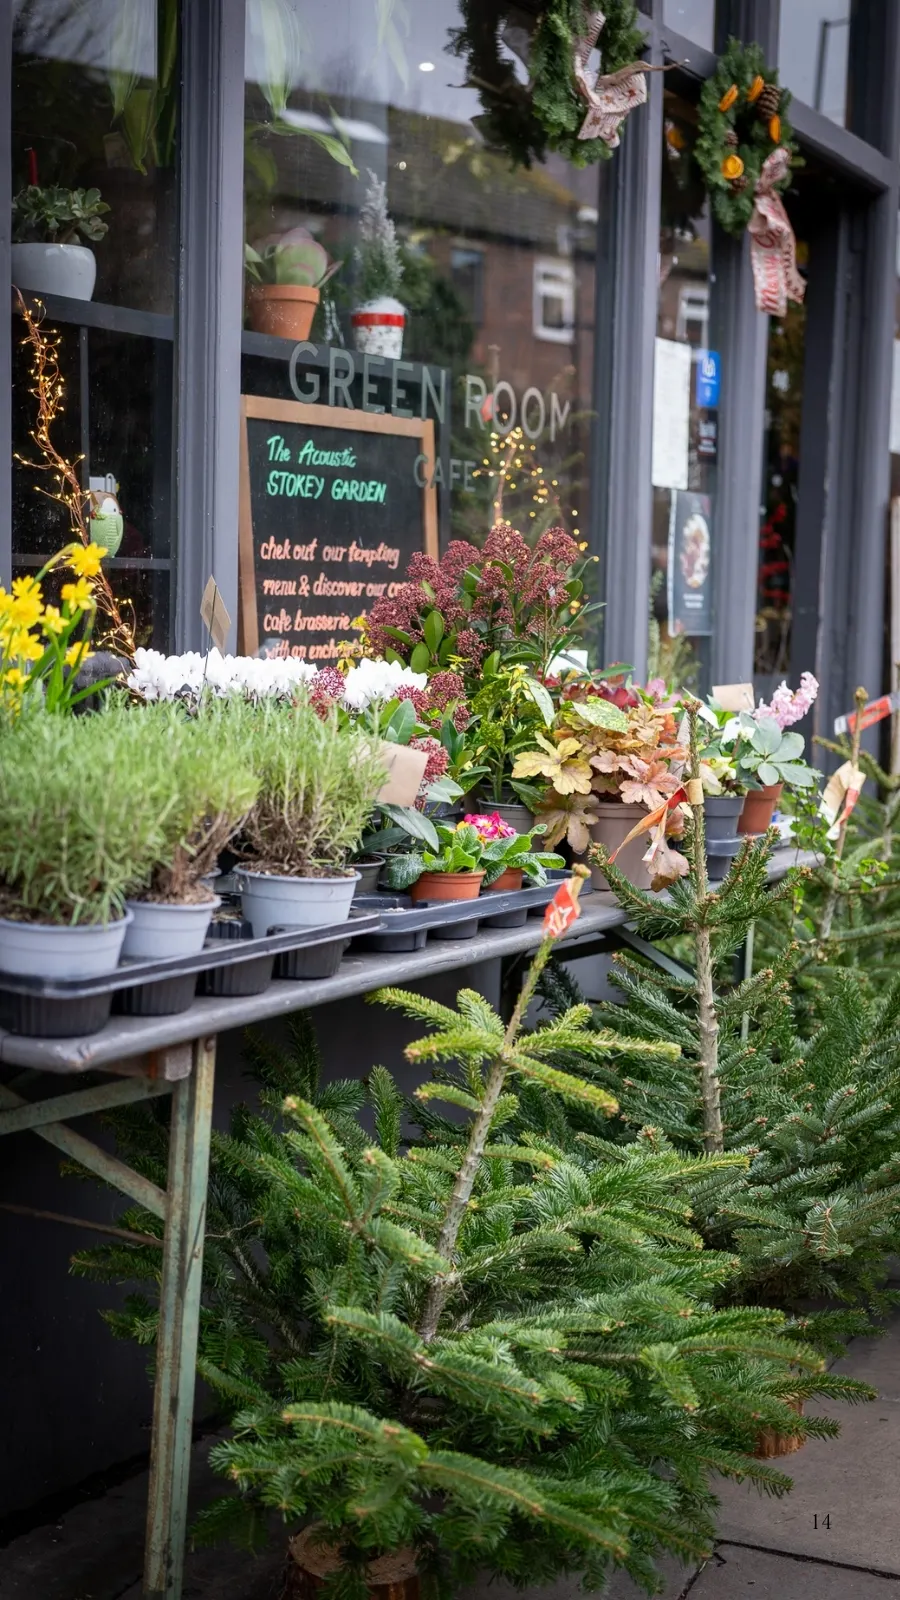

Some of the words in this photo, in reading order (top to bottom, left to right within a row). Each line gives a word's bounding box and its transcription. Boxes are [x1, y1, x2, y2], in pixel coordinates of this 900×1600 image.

[289, 341, 446, 424] GREEN
[465, 375, 570, 442] ROOM
[267, 435, 291, 461] The
[298, 439, 357, 468] Acoustic
[267, 470, 325, 499] STOKEY
[413, 454, 476, 492] CAFE
[260, 535, 291, 560] chek
[293, 538, 318, 561] out
[322, 545, 347, 562] our
[348, 540, 400, 569] tempting
[263, 578, 297, 596] menu
[298, 574, 311, 597] &
[313, 572, 366, 597] discover
[366, 582, 387, 597] our
[294, 609, 351, 631] brasserie
[265, 640, 290, 659] with
[291, 645, 307, 658] an
